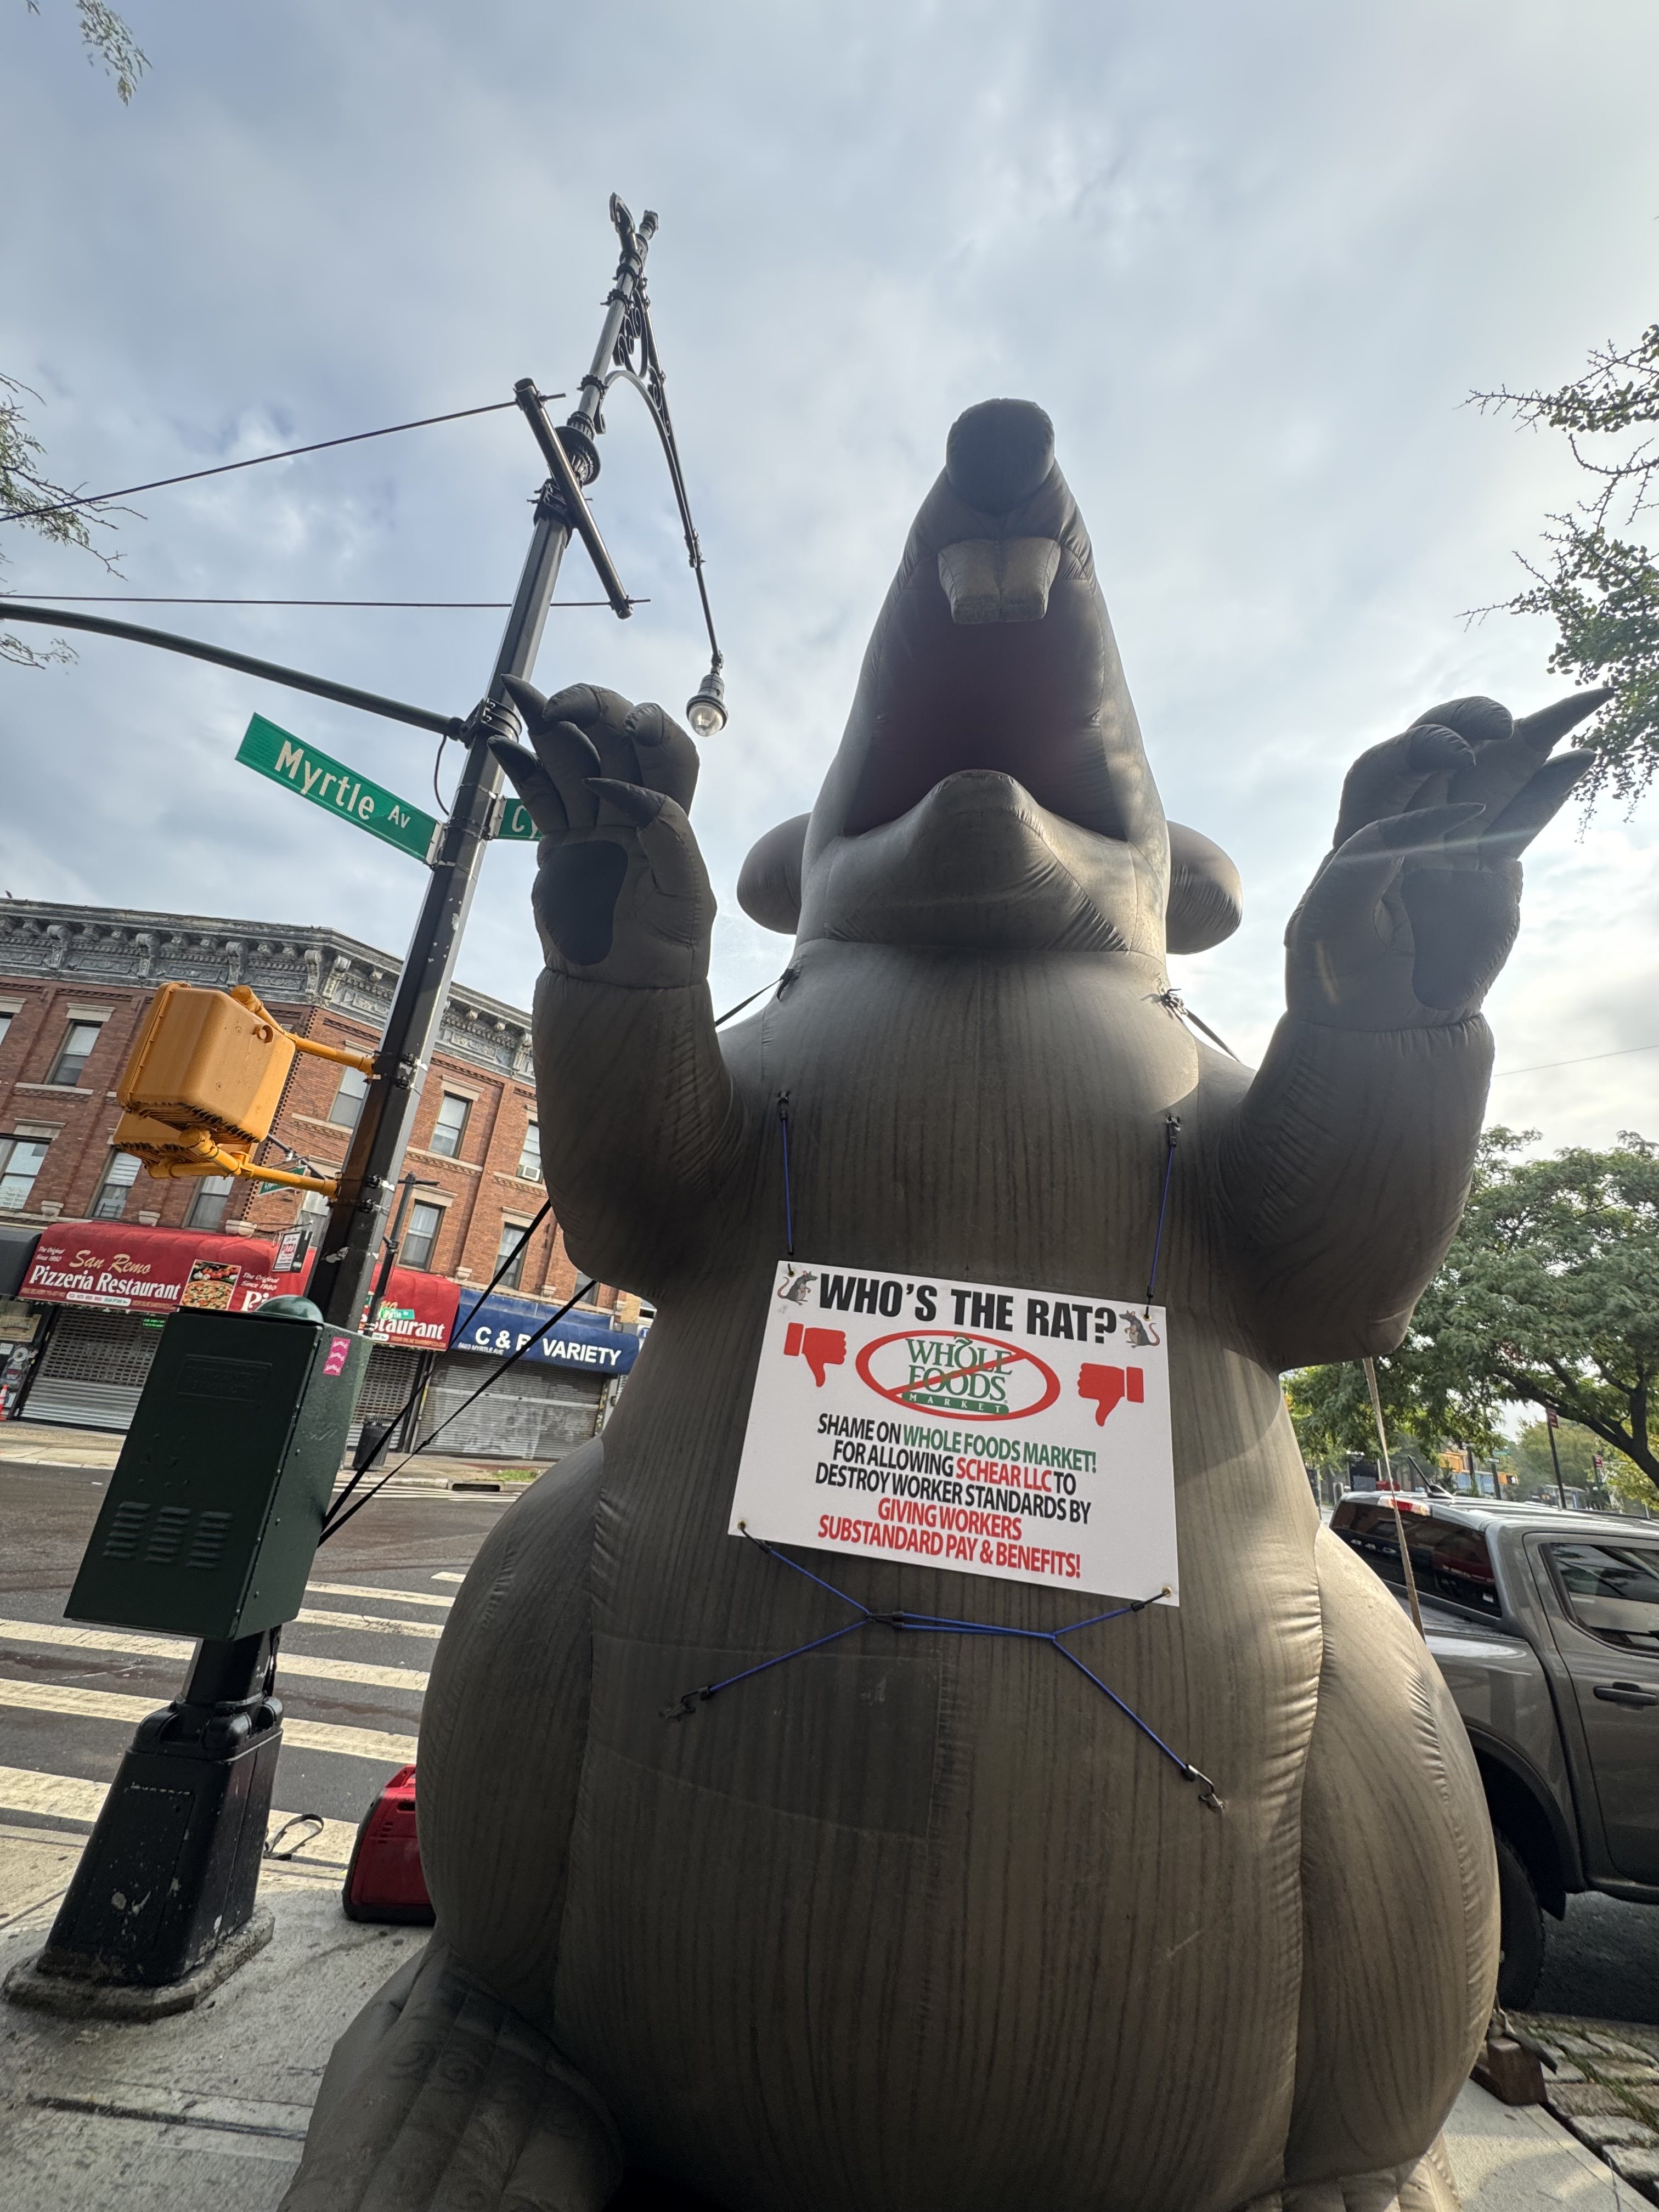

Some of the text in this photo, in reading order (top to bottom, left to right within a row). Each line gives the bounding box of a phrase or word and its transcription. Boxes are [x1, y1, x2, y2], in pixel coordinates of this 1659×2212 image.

[274, 740, 411, 828] Myrtle Av
[29, 1265, 181, 1300] Pizzeria Restaurant
[69, 1250, 151, 1274] San Remo
[255, 1274, 280, 1283] Original
[820, 1273, 1116, 1344] WHO'S THE RAT?
[475, 1327, 492, 1345] C
[495, 1330, 511, 1349] &
[543, 1338, 622, 1365] VARIETY
[905, 1335, 1012, 1375] WHOLE
[908, 1364, 1006, 1401] FOODS
[910, 1394, 1001, 1413] MARKET
[817, 1413, 1097, 1474] SHAME ON WHOLE FOODS MARKET!
[833, 1440, 1076, 1496] FOR ALLOWING SCHEAR LLC TO
[815, 1462, 1091, 1524] DESTROY WORKER STANDARDS BY
[878, 1497, 1022, 1541] GIVING WORKERS
[818, 1514, 1080, 1579] SUBSTANDARD PAY & BENEFITS!
